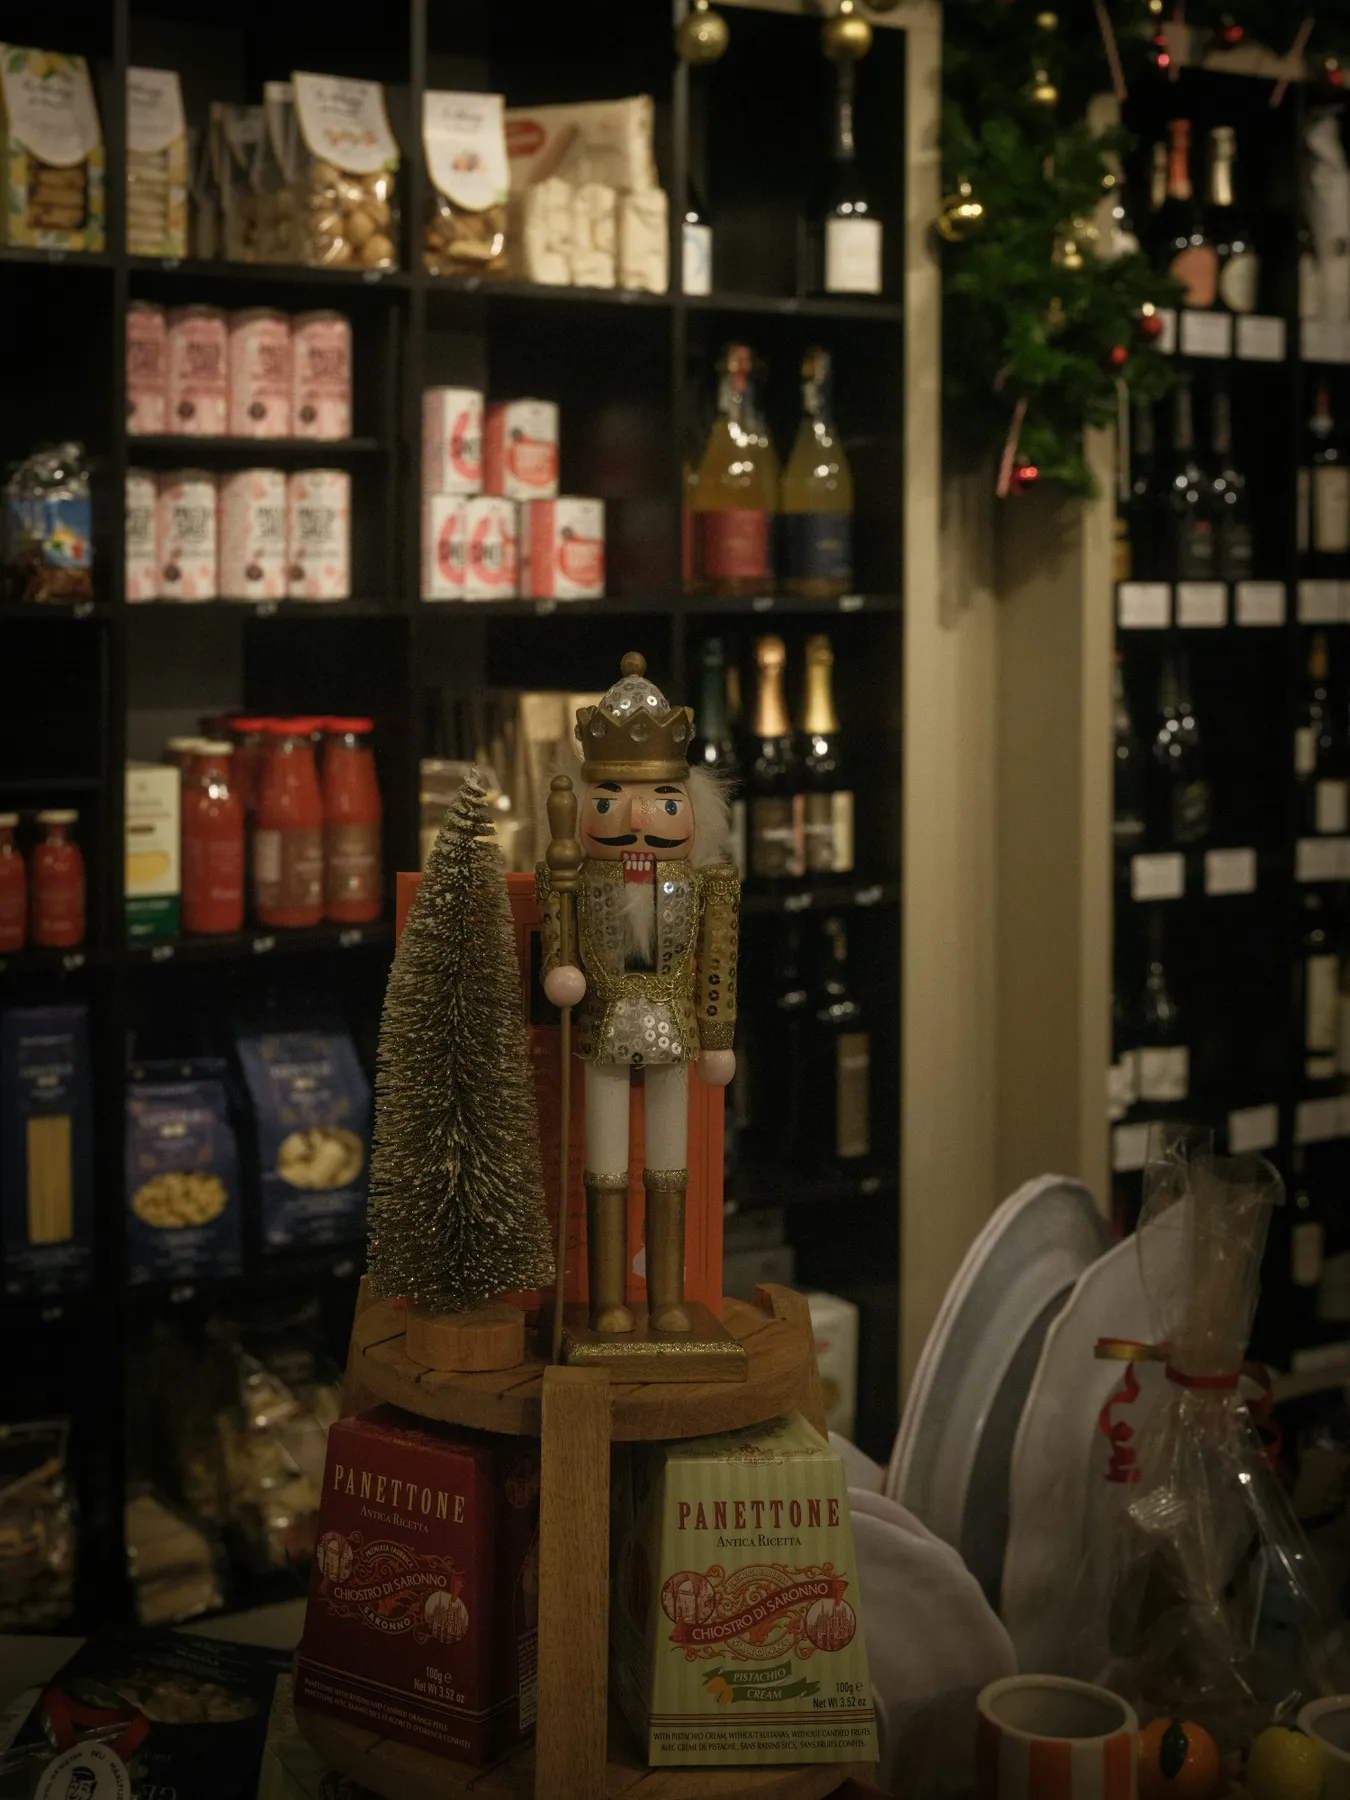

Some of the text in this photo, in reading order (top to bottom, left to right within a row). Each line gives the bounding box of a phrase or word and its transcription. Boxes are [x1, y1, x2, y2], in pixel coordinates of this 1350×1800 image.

[333, 1463, 465, 1523] PANETTONE
[359, 1505, 429, 1534] ANTICA RICETTA
[677, 1498, 840, 1530] PANETTONE
[716, 1534, 802, 1548] ANTICA RICETTA
[333, 1573, 447, 1601] CHIOSTRO DI SARONNO
[363, 1606, 411, 1630] SARONNO
[691, 1582, 829, 1641] CHIOSTRO DI SARONNO
[731, 1636, 790, 1657] SARONNO
[426, 1666, 443, 1684] 100g
[733, 1668, 787, 1682] PISTACHIO
[414, 1678, 466, 1704] Net Wt 3.52 oz
[746, 1689, 783, 1700] CREAM
[836, 1682, 853, 1695] 100g
[813, 1696, 867, 1709] Net Wt 3.52 oz
[653, 1732, 670, 1740] WITH
[671, 1732, 704, 1741] PISTACHIO
[728, 1731, 759, 1740] WITHOUT
[791, 1730, 820, 1739] WITHOUT
[822, 1729, 849, 1738] CANDIED
[660, 1743, 676, 1751] AVEC
[699, 1743, 707, 1751] DE
[740, 1741, 756, 1750] SANS
[757, 1740, 782, 1749] RAISINS
[800, 1740, 816, 1749] SANS
[817, 1740, 837, 1749] FRUITS
